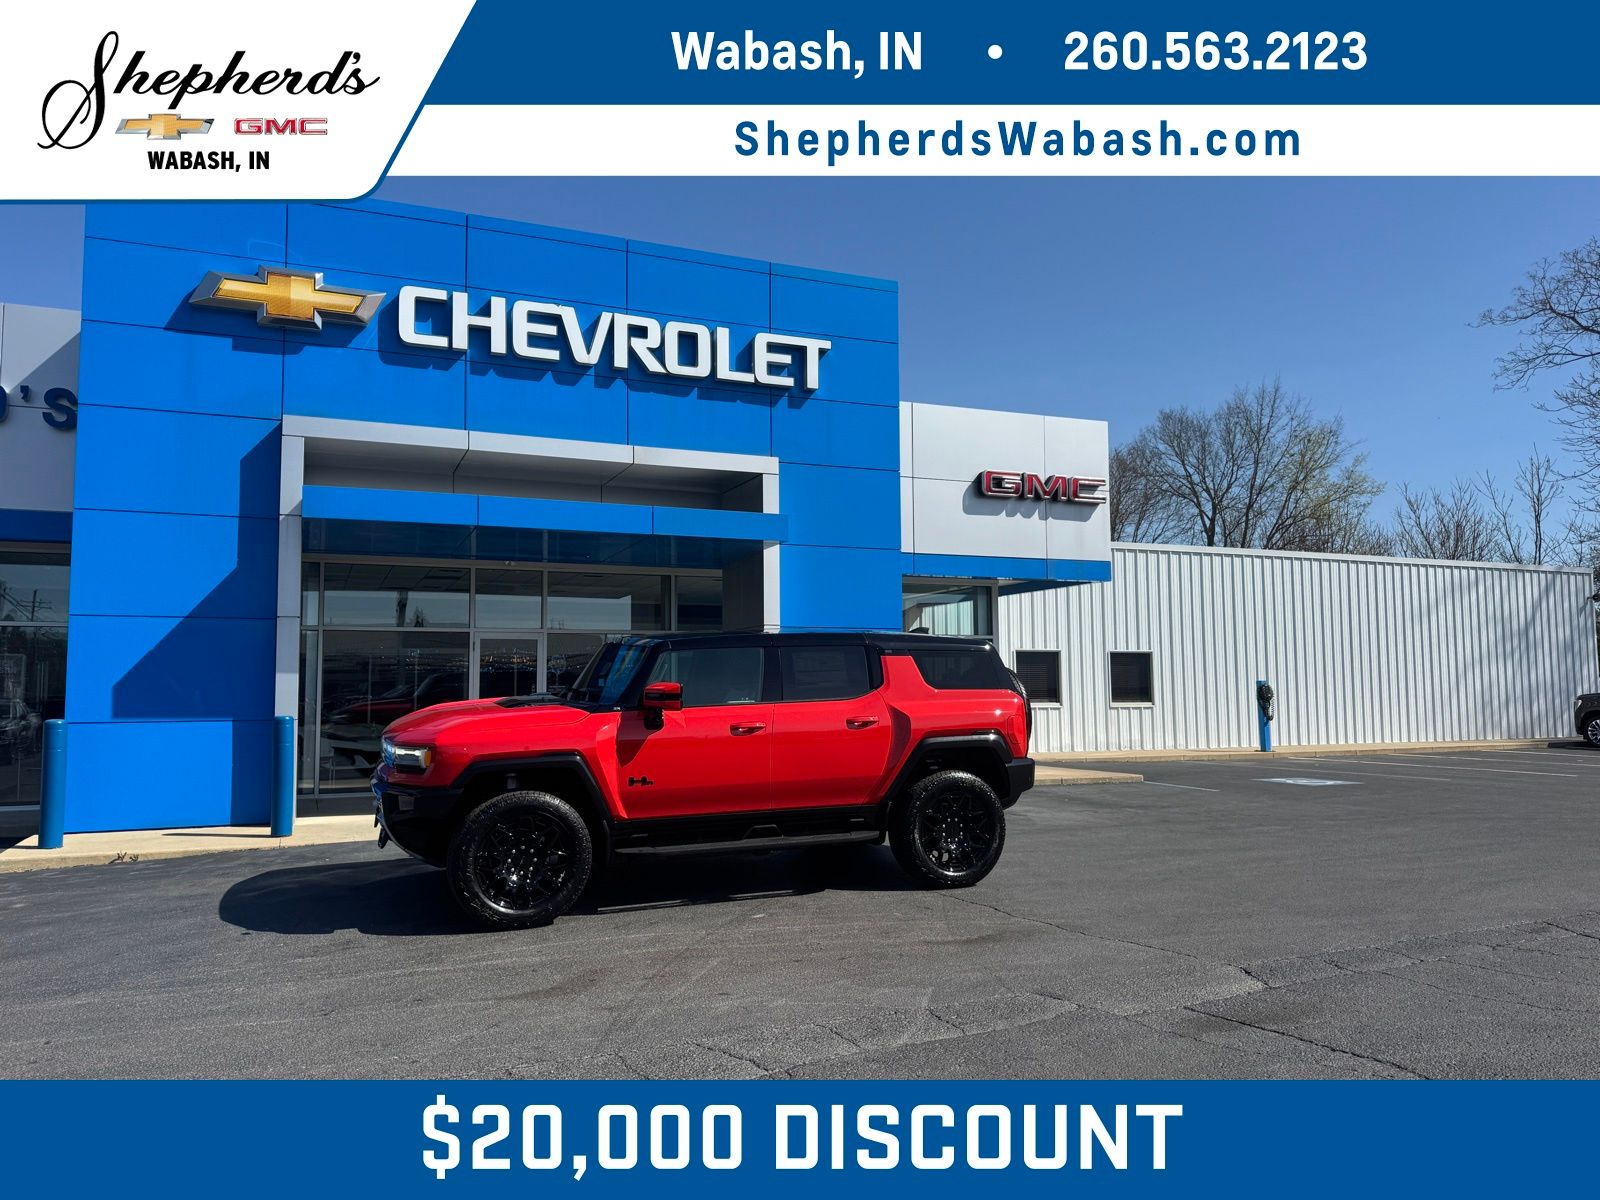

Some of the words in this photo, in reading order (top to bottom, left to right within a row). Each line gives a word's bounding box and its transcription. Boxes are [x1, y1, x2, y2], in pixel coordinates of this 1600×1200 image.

[398, 285, 832, 390] CHEVROLET
[0, 384, 78, 431] 'S
[980, 470, 1107, 504] GMC
